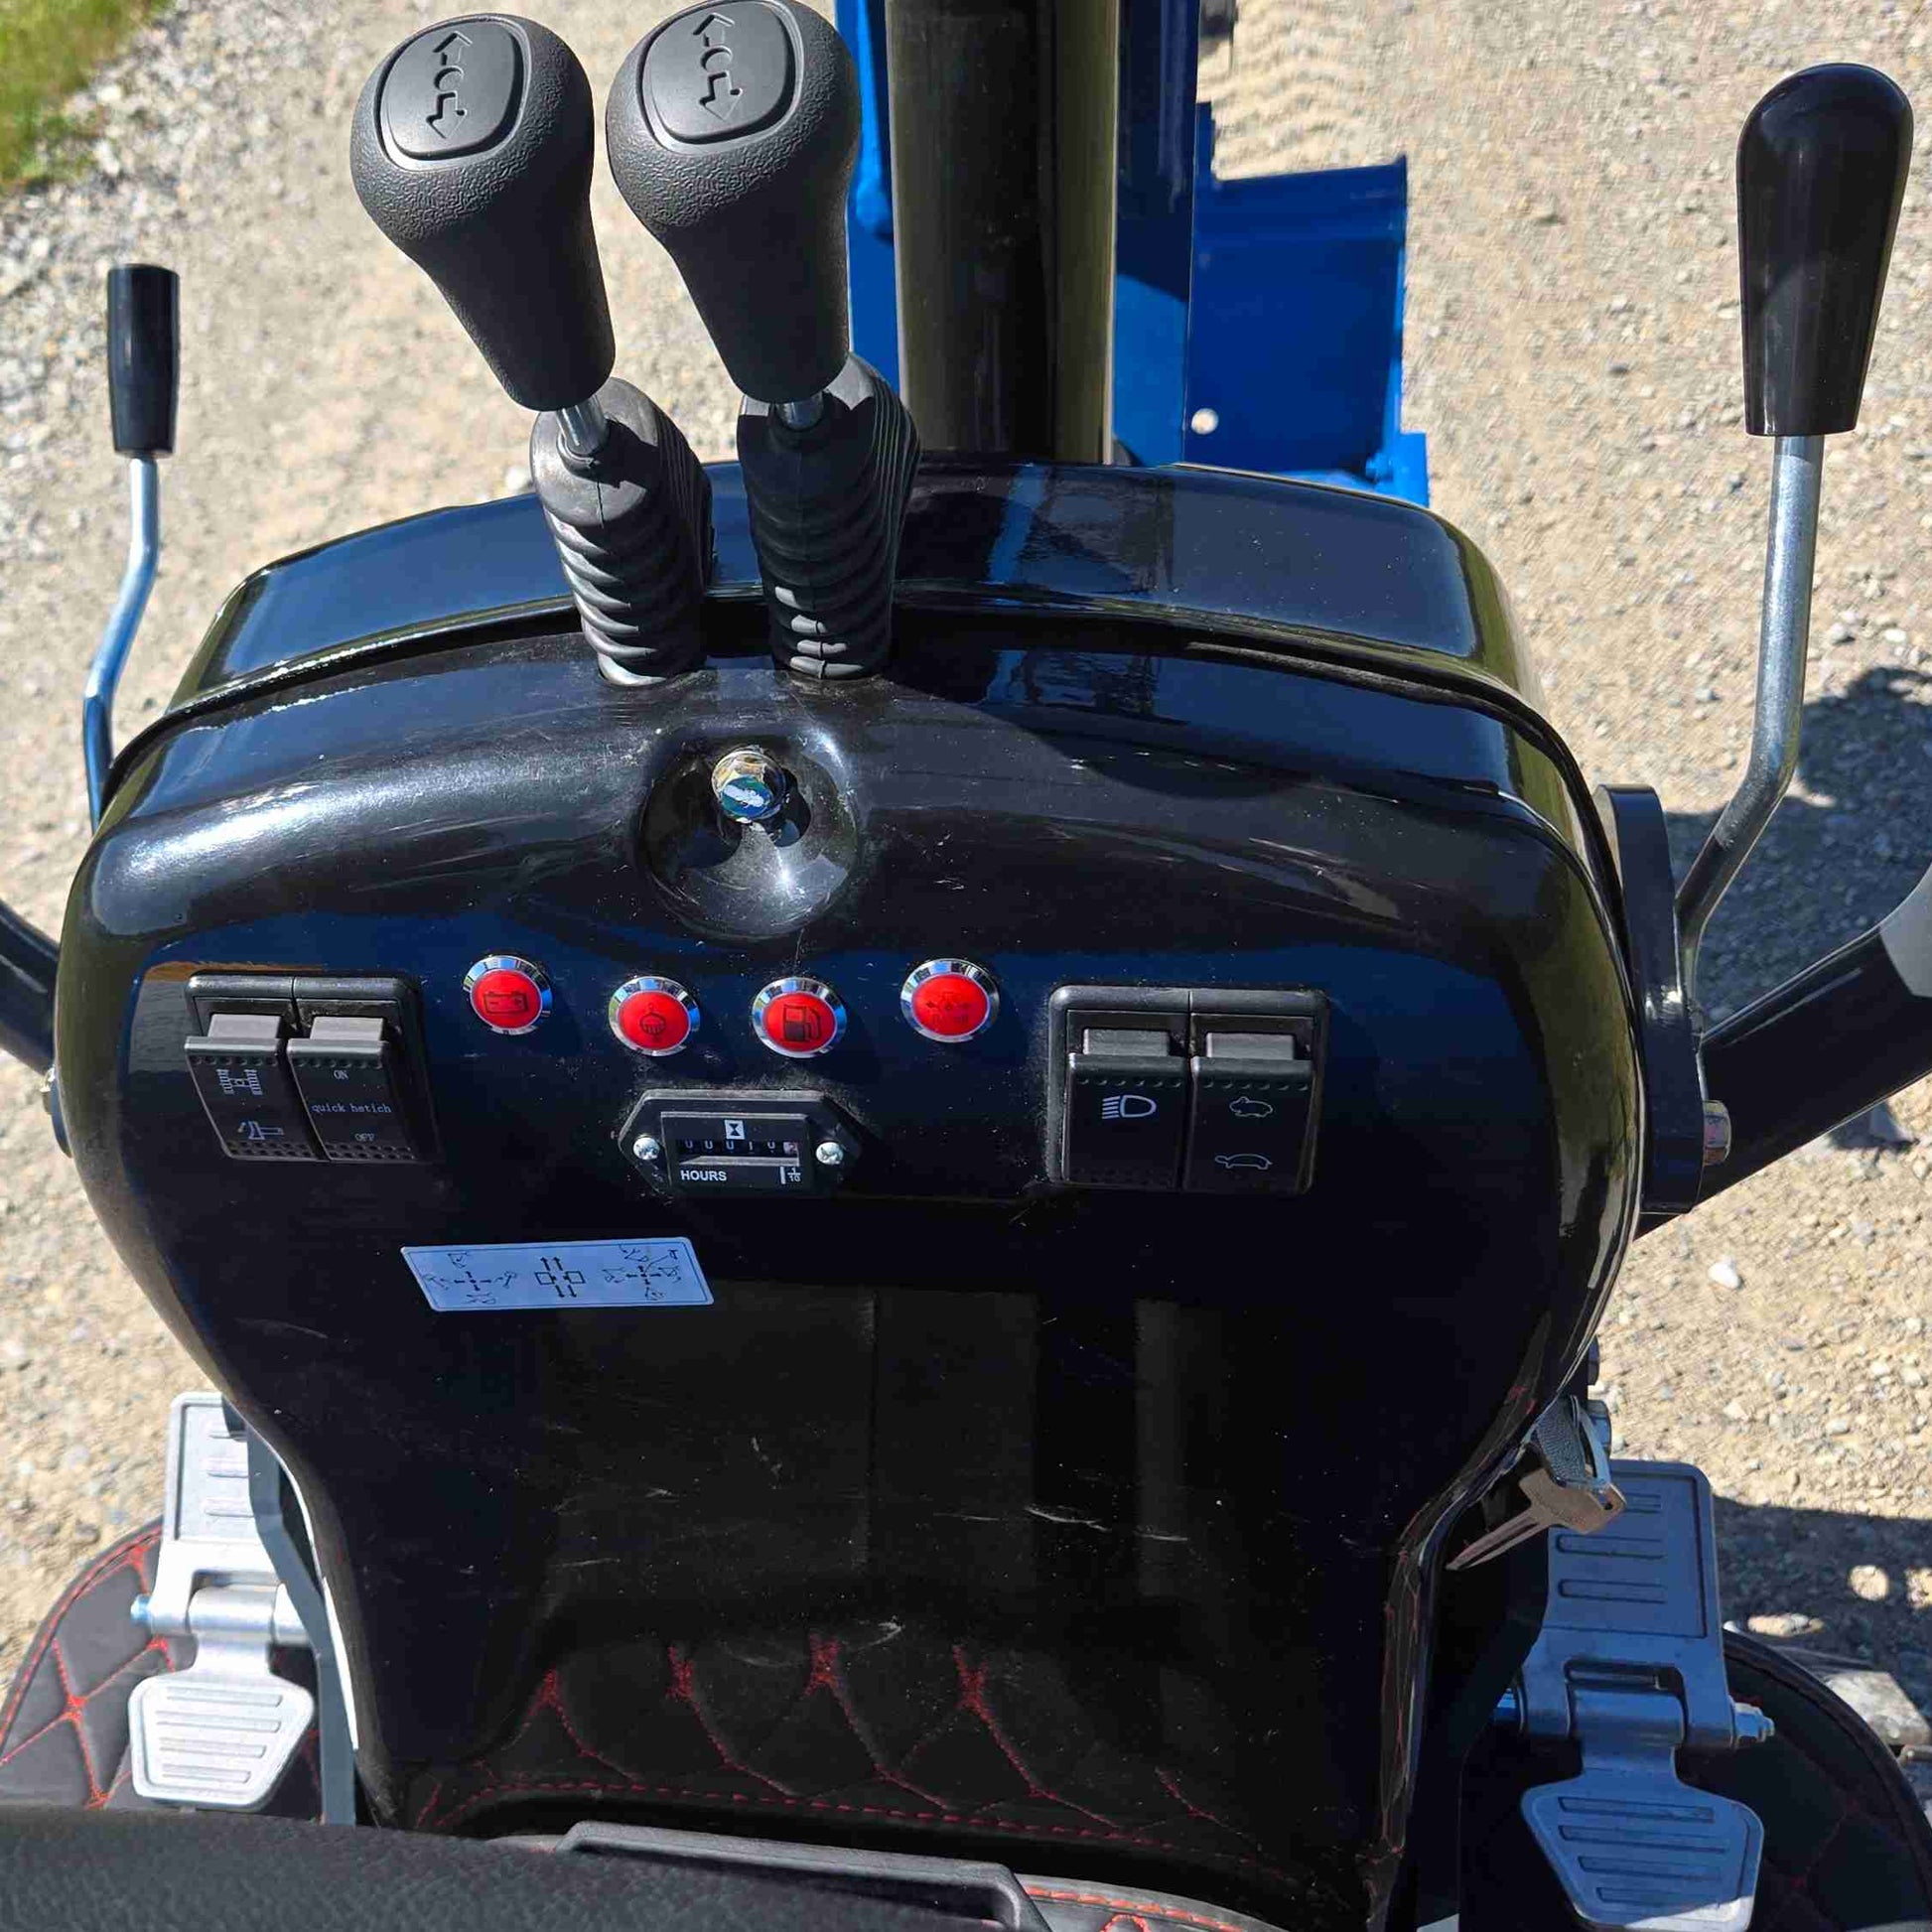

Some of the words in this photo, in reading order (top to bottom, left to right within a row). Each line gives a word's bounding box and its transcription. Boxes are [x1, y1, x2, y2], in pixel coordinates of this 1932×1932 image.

[333, 1069, 349, 1080] ON
[311, 1103, 345, 1114] quick
[680, 1170, 728, 1181] HOURS
